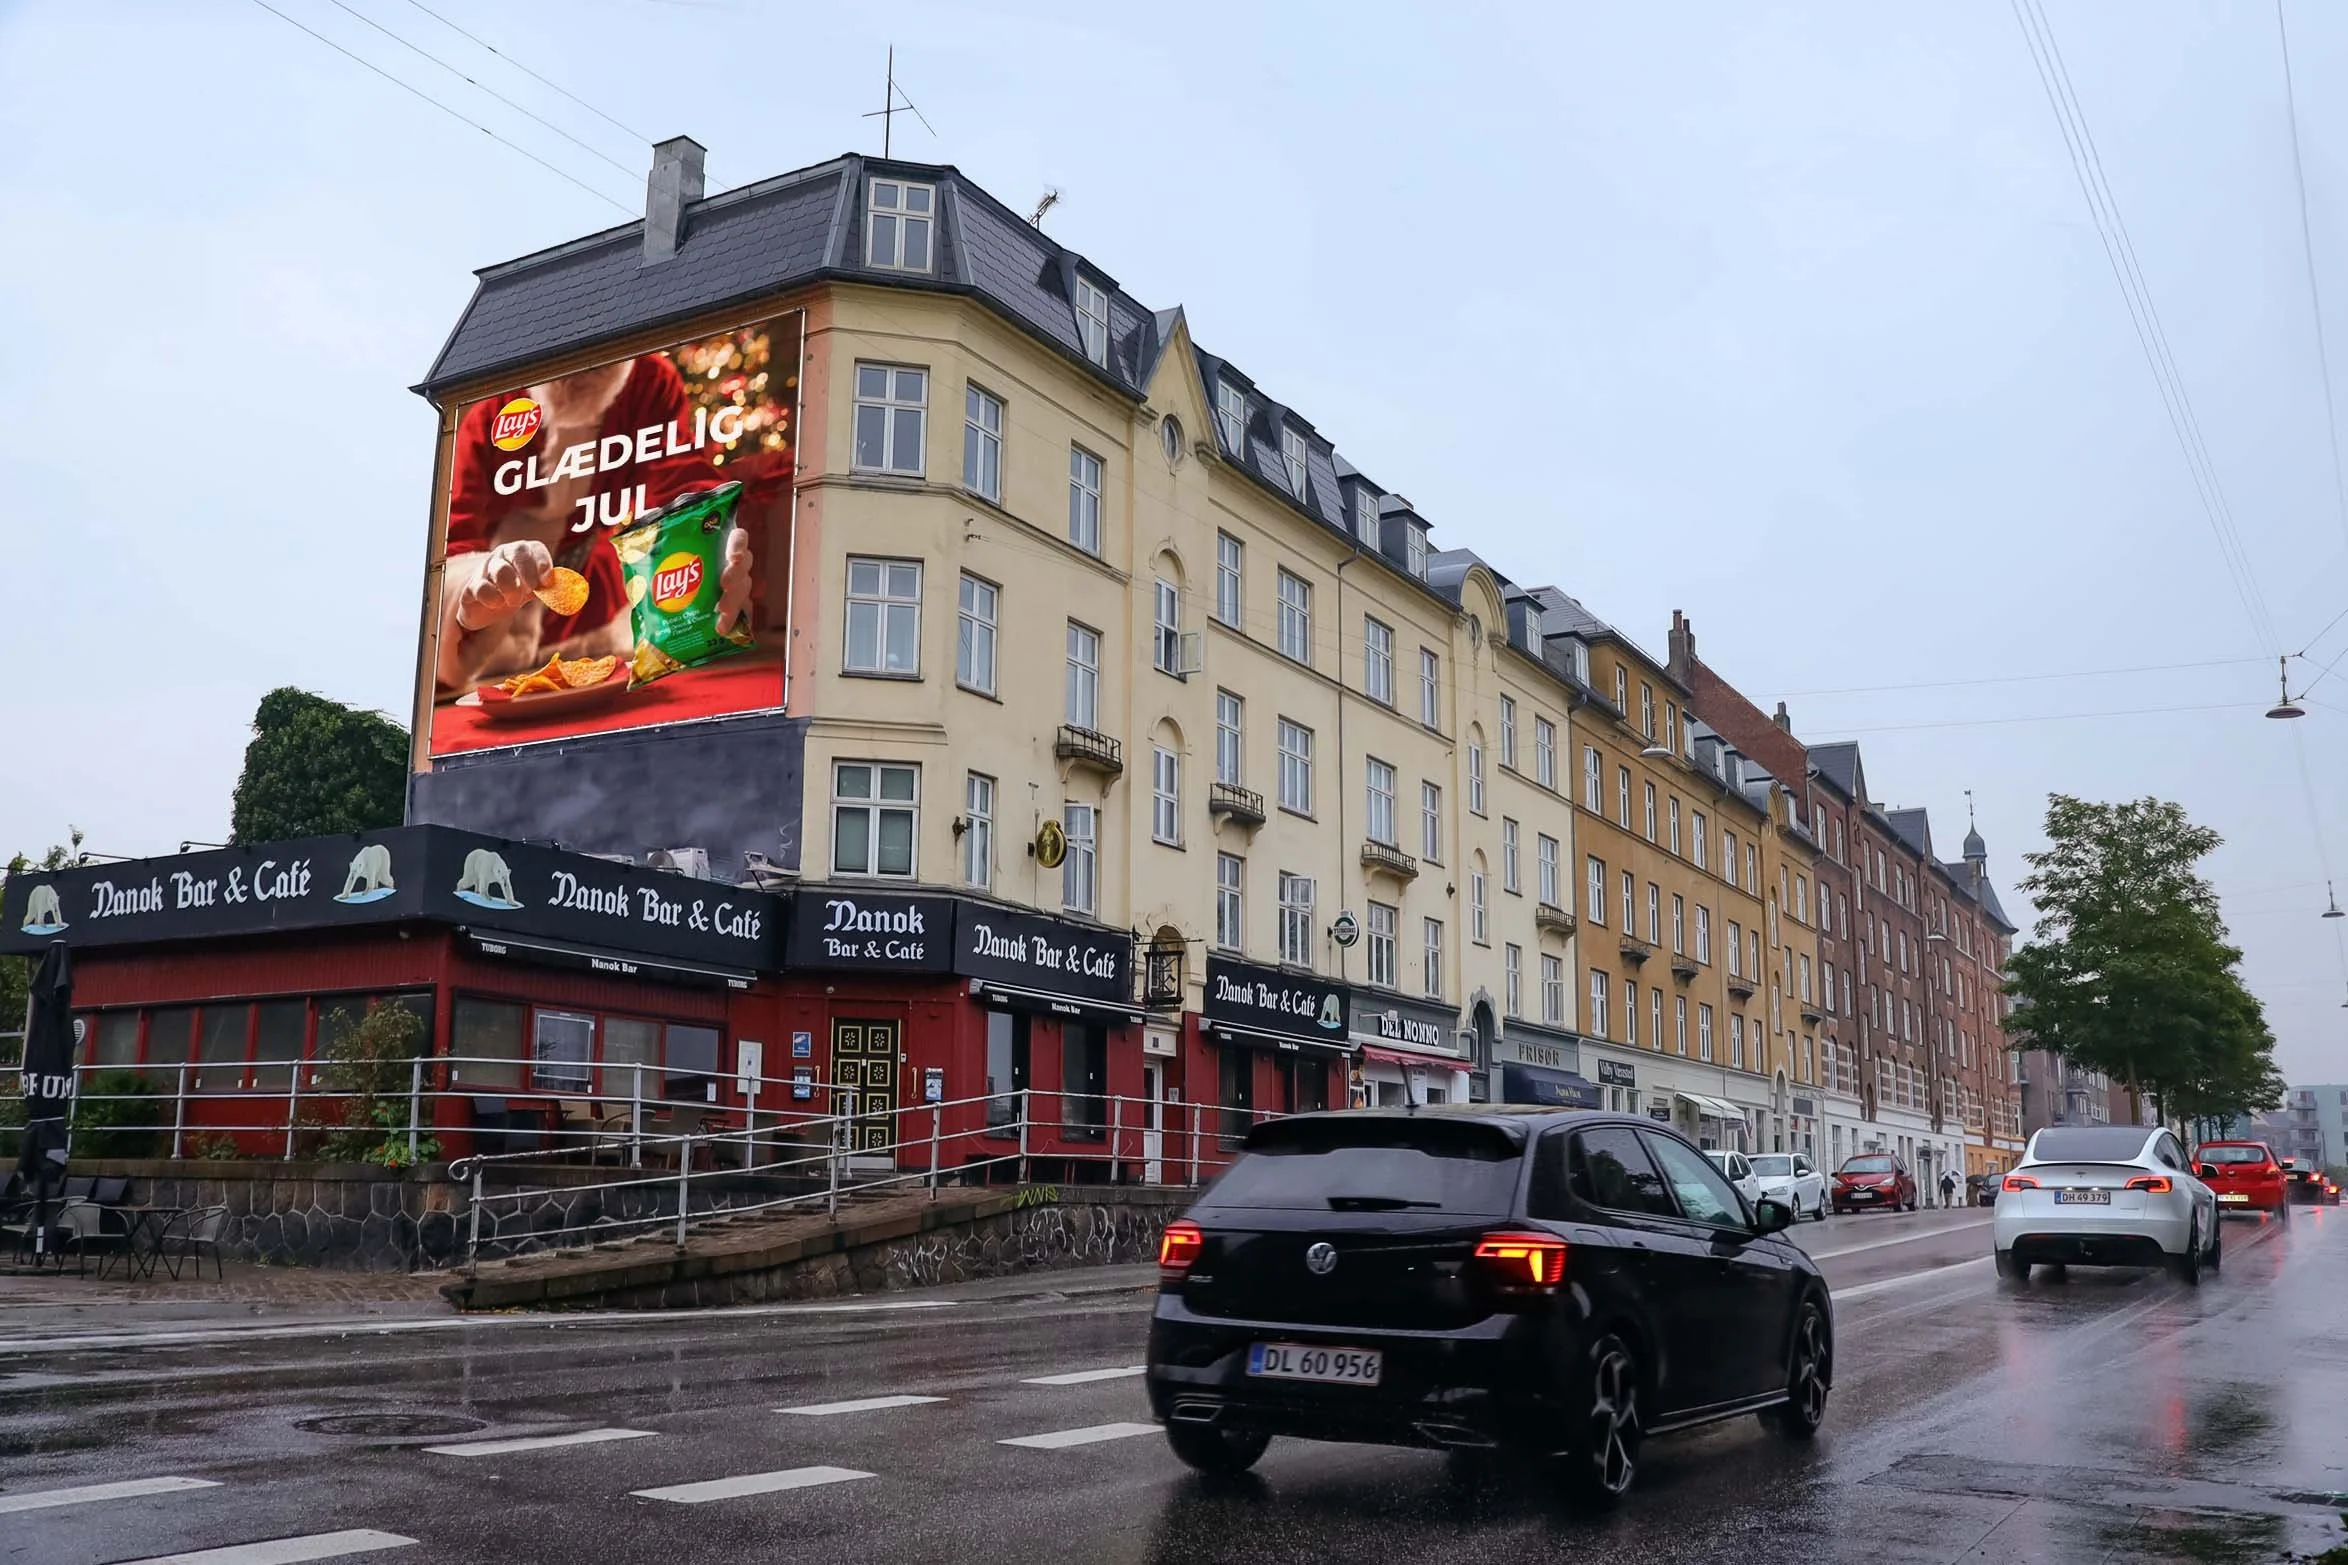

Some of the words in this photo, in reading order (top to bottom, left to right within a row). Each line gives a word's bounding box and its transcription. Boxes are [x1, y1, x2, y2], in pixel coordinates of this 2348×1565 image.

[496, 409, 538, 438] Lay's
[493, 405, 744, 496] GLÆDELIG
[571, 483, 660, 533] JUL
[656, 561, 700, 602] Lay's
[89, 876, 164, 919] Nanok
[170, 870, 218, 909] Bar
[224, 866, 248, 905] &
[254, 858, 312, 901] Café
[548, 871, 630, 918] Nanok
[636, 887, 683, 926] Bar
[687, 899, 710, 932] &
[714, 902, 761, 940] Café
[823, 900, 925, 934] Nanok
[481, 943, 507, 955] TUBORG
[823, 938, 859, 957] Bar
[863, 940, 881, 958] &
[885, 940, 924, 960] Café
[973, 924, 1027, 963] Nanok
[1031, 935, 1063, 969] Bar
[1065, 945, 1081, 973] &
[1083, 947, 1116, 979] Café
[591, 958, 620, 972] Nanok
[622, 963, 638, 974] Bar
[1216, 974, 1254, 1005] Nanok
[1256, 983, 1279, 1010] Bar
[1280, 989, 1291, 1013] &
[1292, 990, 1316, 1017] Café
[1380, 1015, 1400, 1038] DEL
[1403, 1019, 1439, 1045] NONNO
[1518, 1043, 1560, 1067] FRISØR
[2062, 1193, 2075, 1201] DH
[2090, 1193, 2107, 1201] 379
[1265, 1349, 1293, 1372] DL
[1300, 1351, 1328, 1374] 60
[1334, 1353, 1378, 1378] 956
